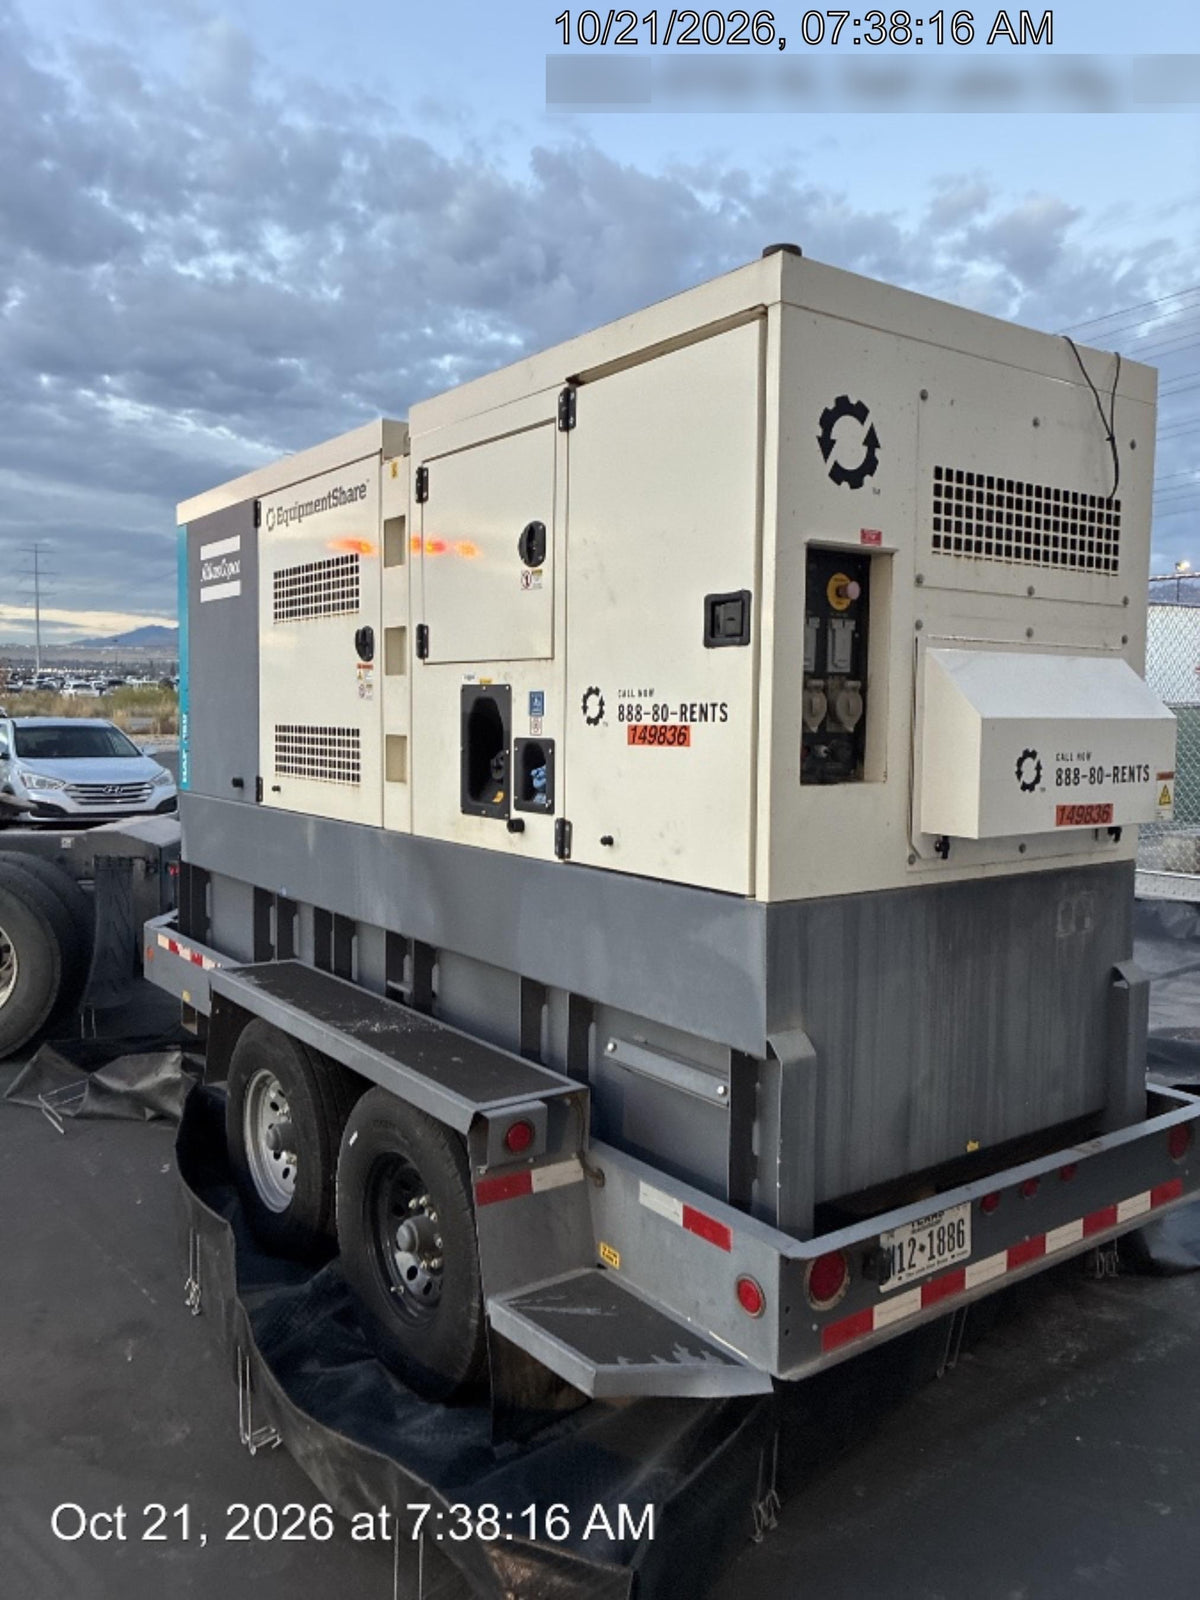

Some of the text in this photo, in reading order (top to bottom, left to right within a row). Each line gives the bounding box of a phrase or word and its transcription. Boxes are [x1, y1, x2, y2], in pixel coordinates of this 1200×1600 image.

[276, 483, 367, 527] EquipmentShare
[617, 702, 728, 723] 888-80-RENTS
[630, 725, 688, 745] 149836
[1055, 764, 1150, 787] 888-80-RENTS
[1057, 803, 1110, 825] 149836
